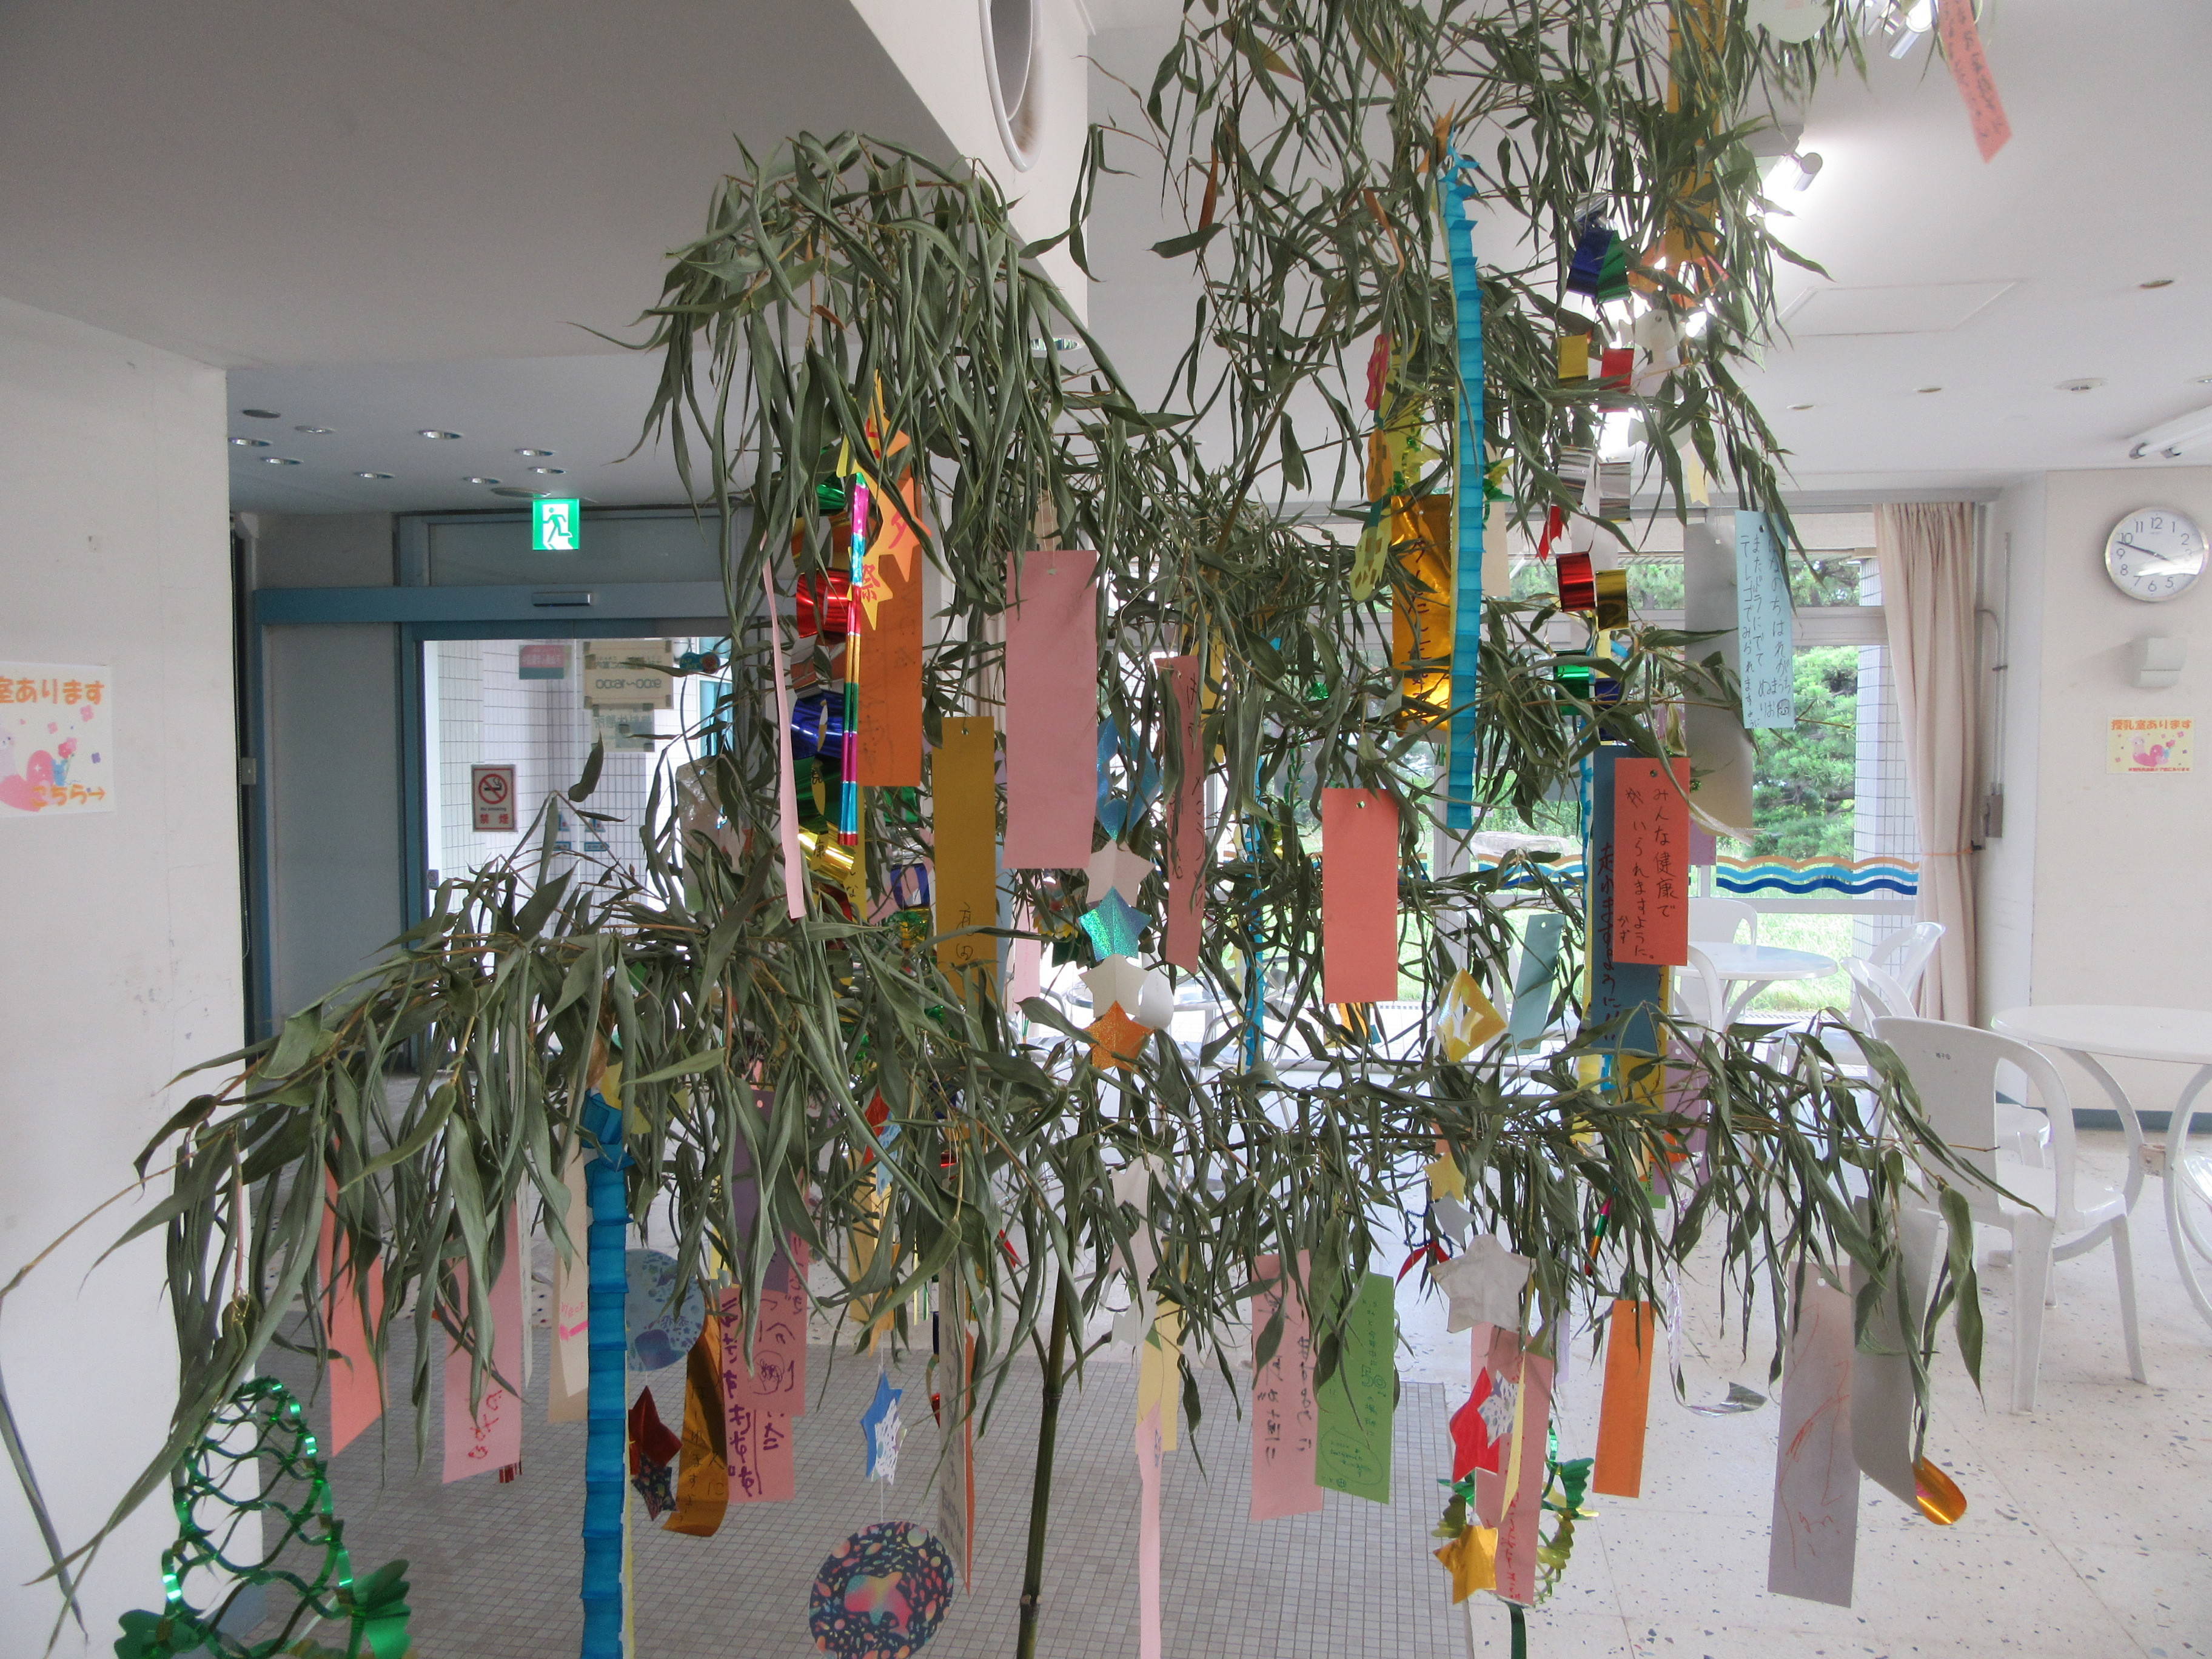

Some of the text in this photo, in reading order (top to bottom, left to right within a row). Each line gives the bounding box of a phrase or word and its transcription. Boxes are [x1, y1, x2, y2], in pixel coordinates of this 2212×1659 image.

[2135, 521, 2144, 533] 11
[2150, 517, 2163, 529] 12
[2172, 521, 2176, 533] 1
[2120, 532, 2133, 545] 10
[2180, 533, 2190, 545] 2
[2116, 548, 2125, 560] 9
[2120, 564, 2128, 575] 8
[2133, 575, 2142, 586] 7
[2148, 580, 2157, 592] 6
[2165, 577, 2174, 588] 5
[1652, 789, 1679, 917] みんな健康で
